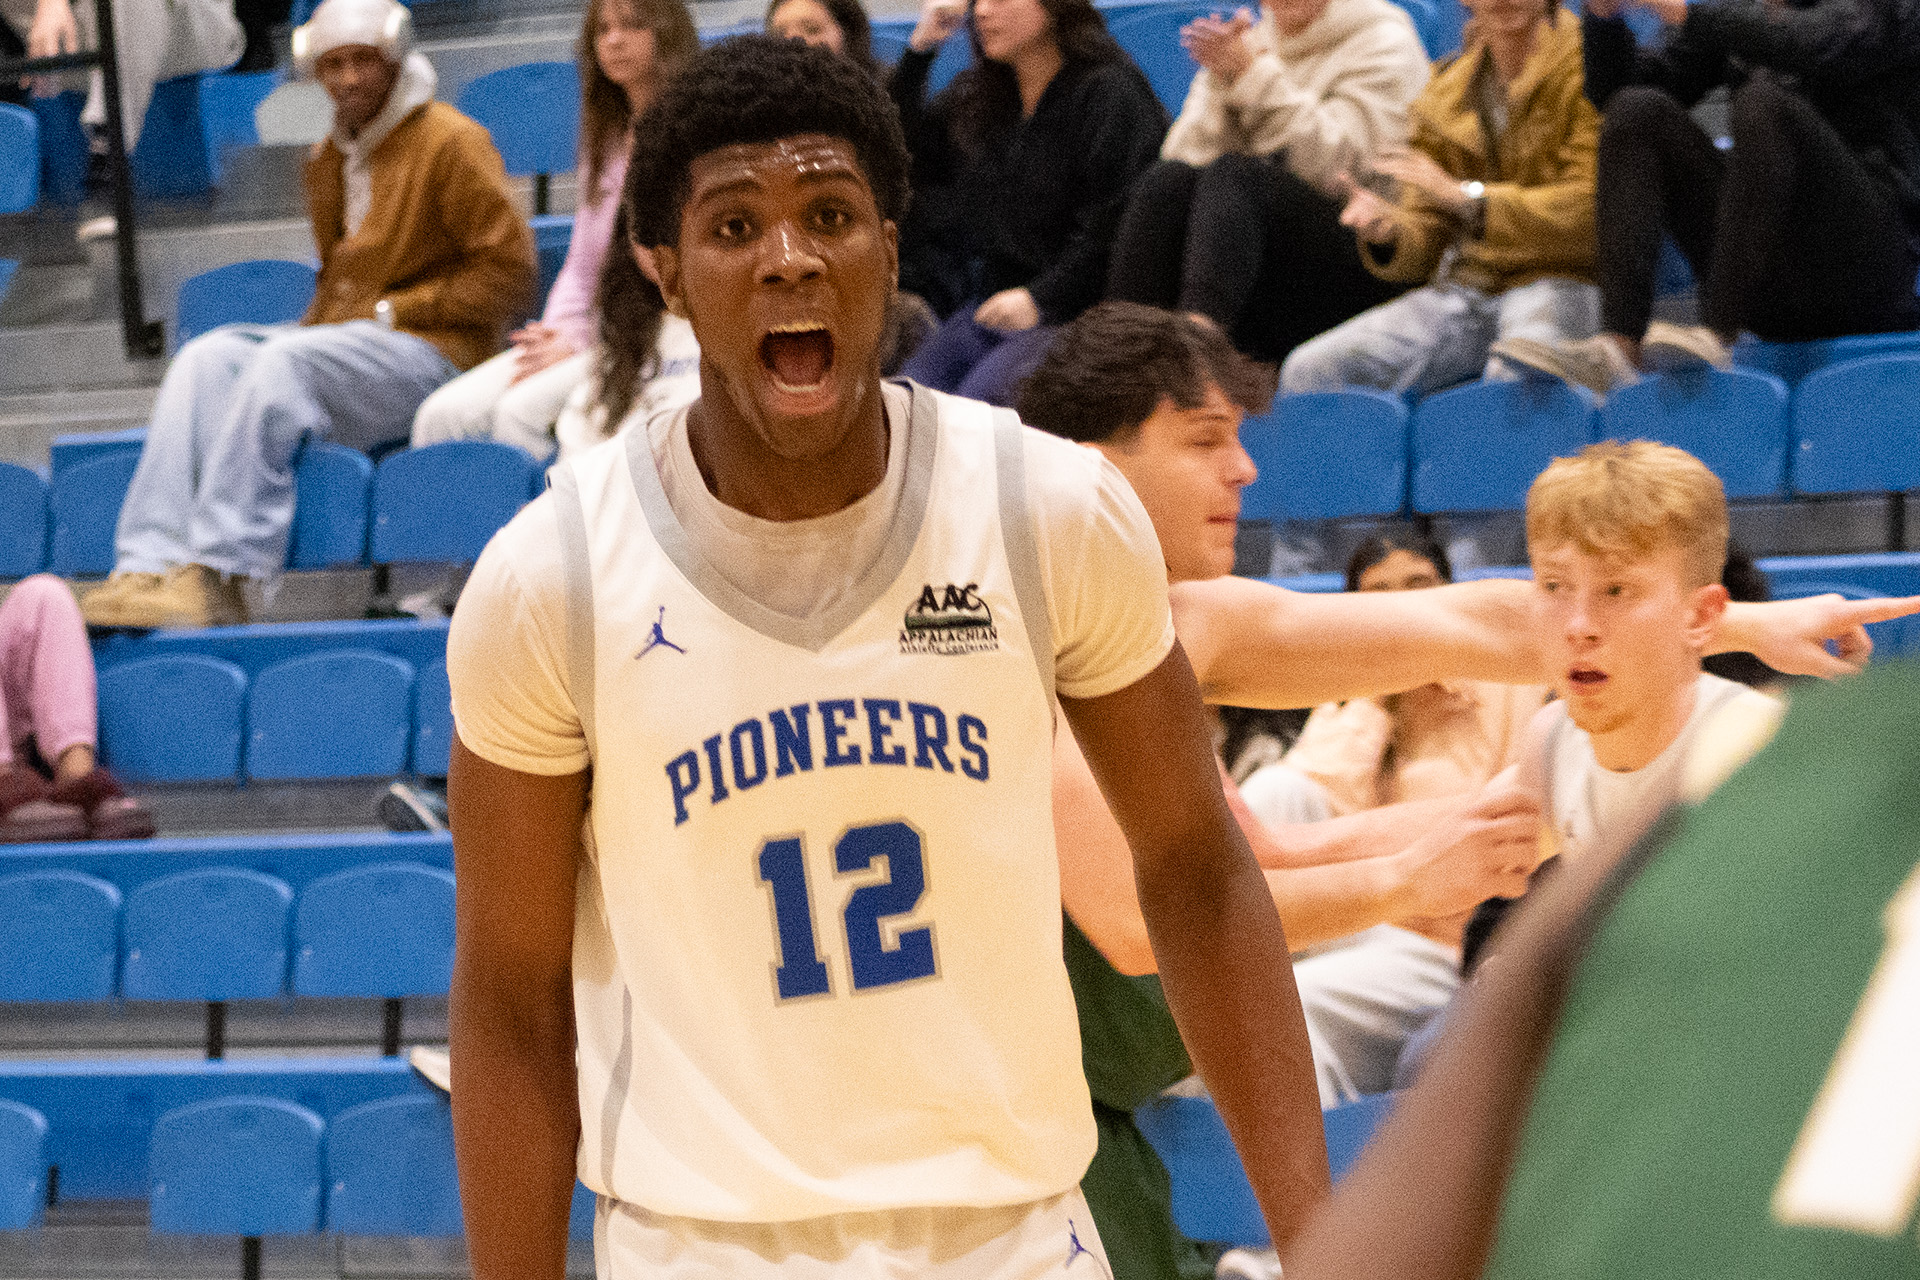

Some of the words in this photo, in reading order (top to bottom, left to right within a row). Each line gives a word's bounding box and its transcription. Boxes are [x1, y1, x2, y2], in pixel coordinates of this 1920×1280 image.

[899, 627, 998, 643] APPALACHIAN
[916, 583, 982, 612] AAC
[665, 698, 990, 827] PIONEERS
[753, 818, 941, 1005] 12
